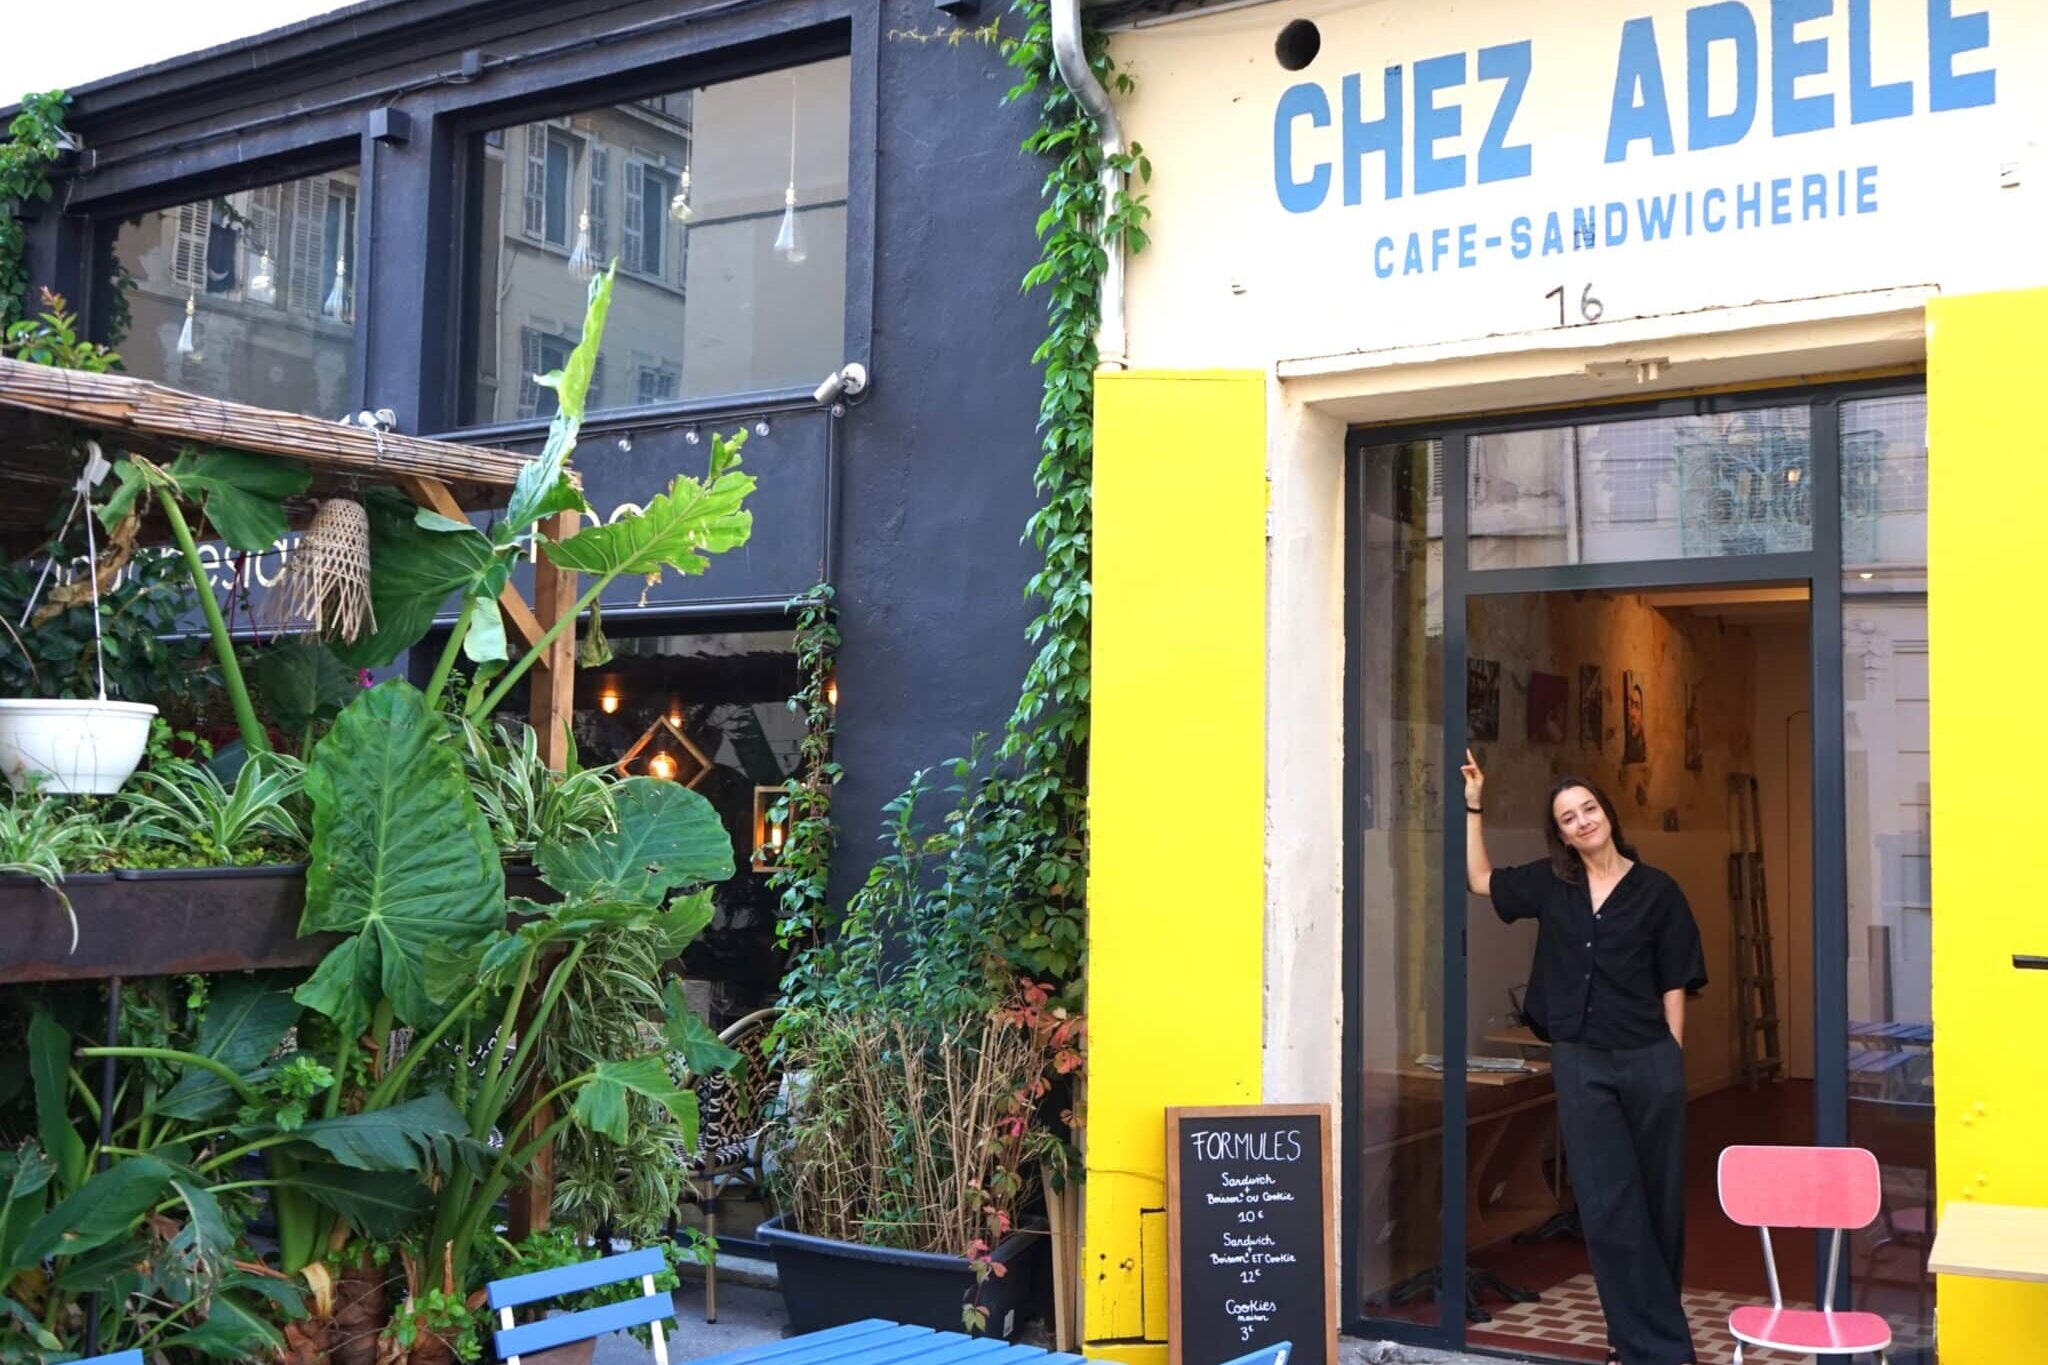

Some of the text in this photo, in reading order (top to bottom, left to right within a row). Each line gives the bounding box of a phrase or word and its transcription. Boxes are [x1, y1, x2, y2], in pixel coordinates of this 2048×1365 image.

[1273, 0, 1997, 214] CHEZ ADELE
[1373, 165, 1879, 279] CAFE-SANDWICHERIE
[1545, 283, 1604, 326] 16
[1190, 1129, 1301, 1162] FORMULES
[1221, 1171, 1276, 1187] Sandwich
[1223, 1232, 1276, 1247] Sandwich
[1251, 1253, 1264, 1264] ET
[1225, 1299, 1277, 1316] Cookies
